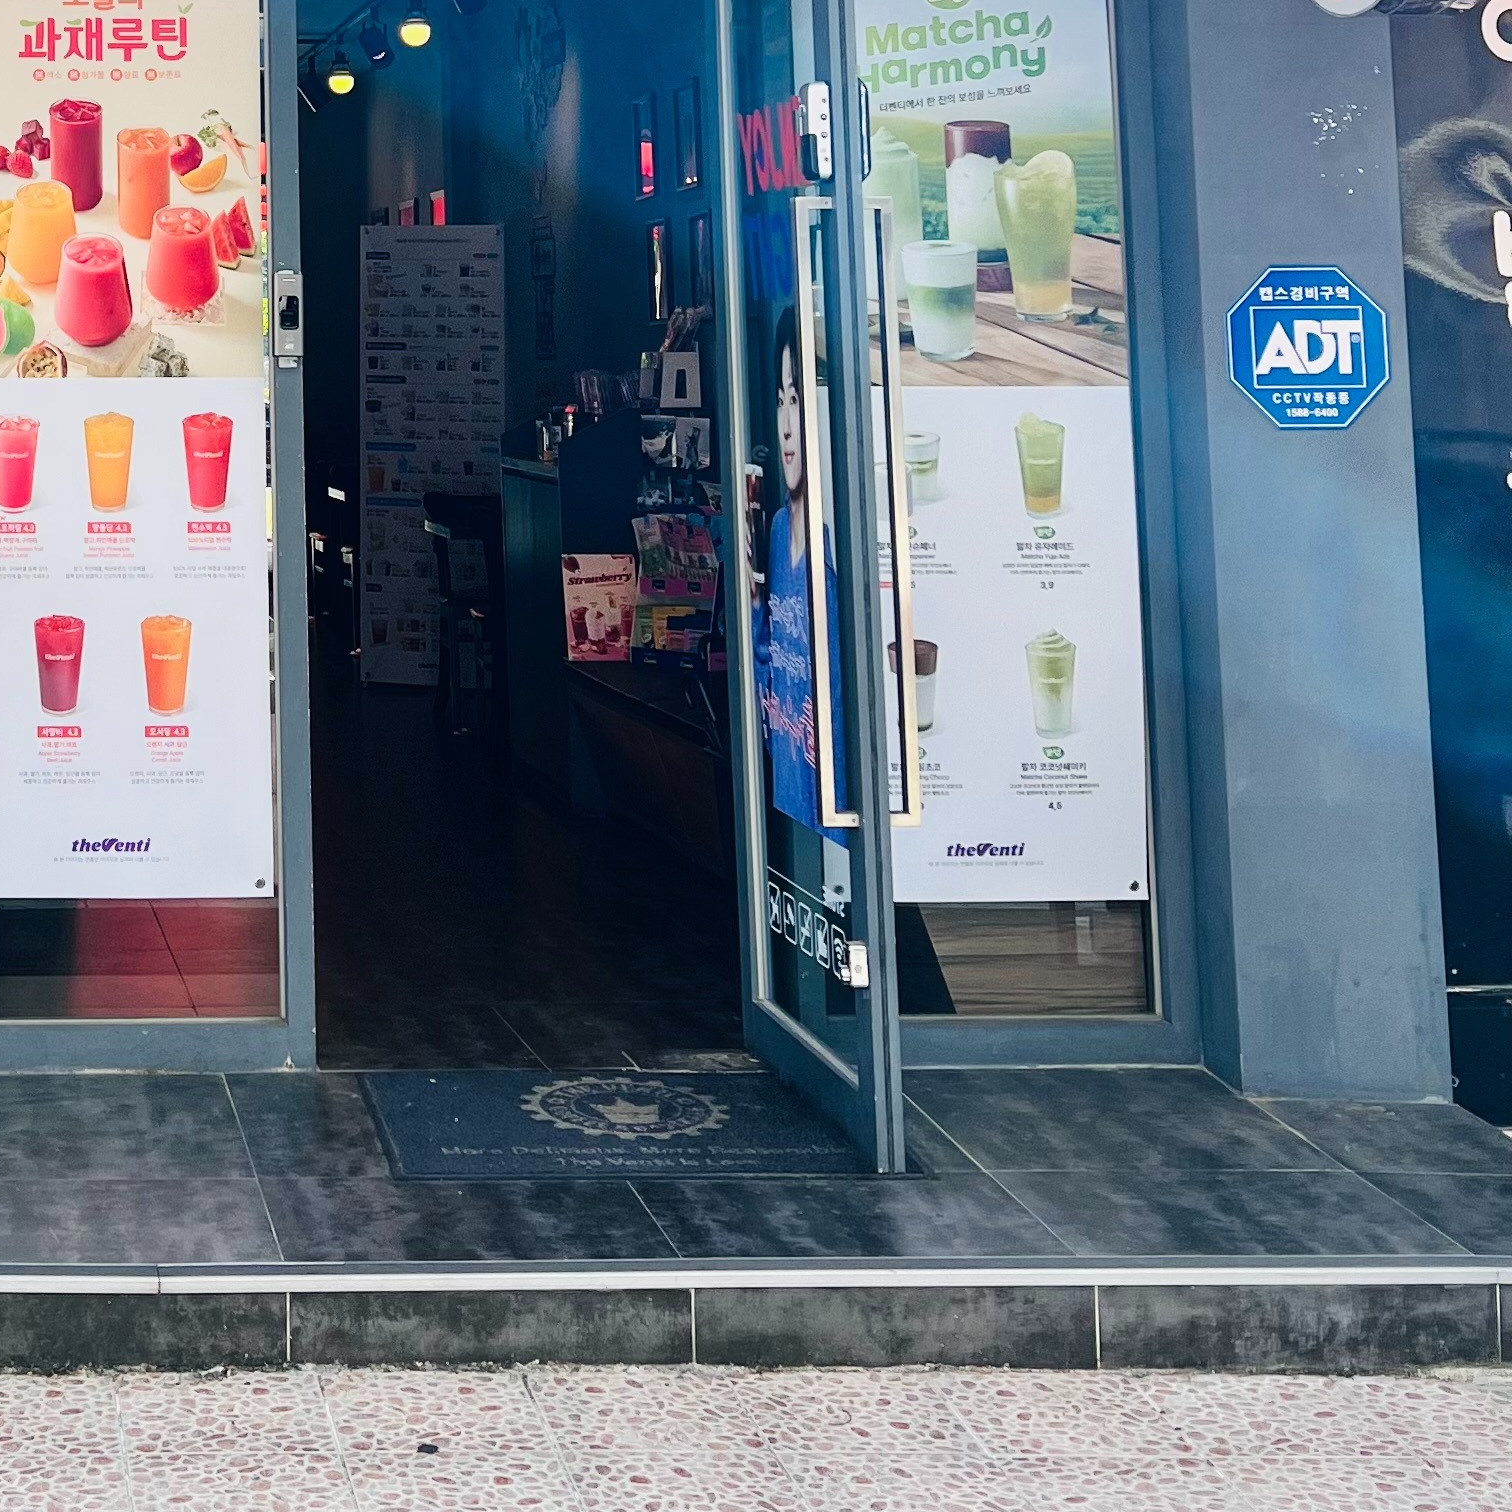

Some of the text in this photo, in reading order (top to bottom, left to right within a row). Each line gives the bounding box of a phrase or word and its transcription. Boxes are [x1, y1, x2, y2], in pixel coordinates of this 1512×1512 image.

[18, 15, 189, 63] 과채루틴
[864, 8, 1030, 56] Matcha
[879, 98, 924, 112] 더벤티에서
[937, 94, 956, 106] 잔의
[958, 89, 985, 103] 보성을
[1258, 285, 1350, 302] 캡스경비구역
[1255, 319, 1362, 375] ADT
[71, 837, 151, 853] theVenti
[946, 842, 1026, 857] theVenti
